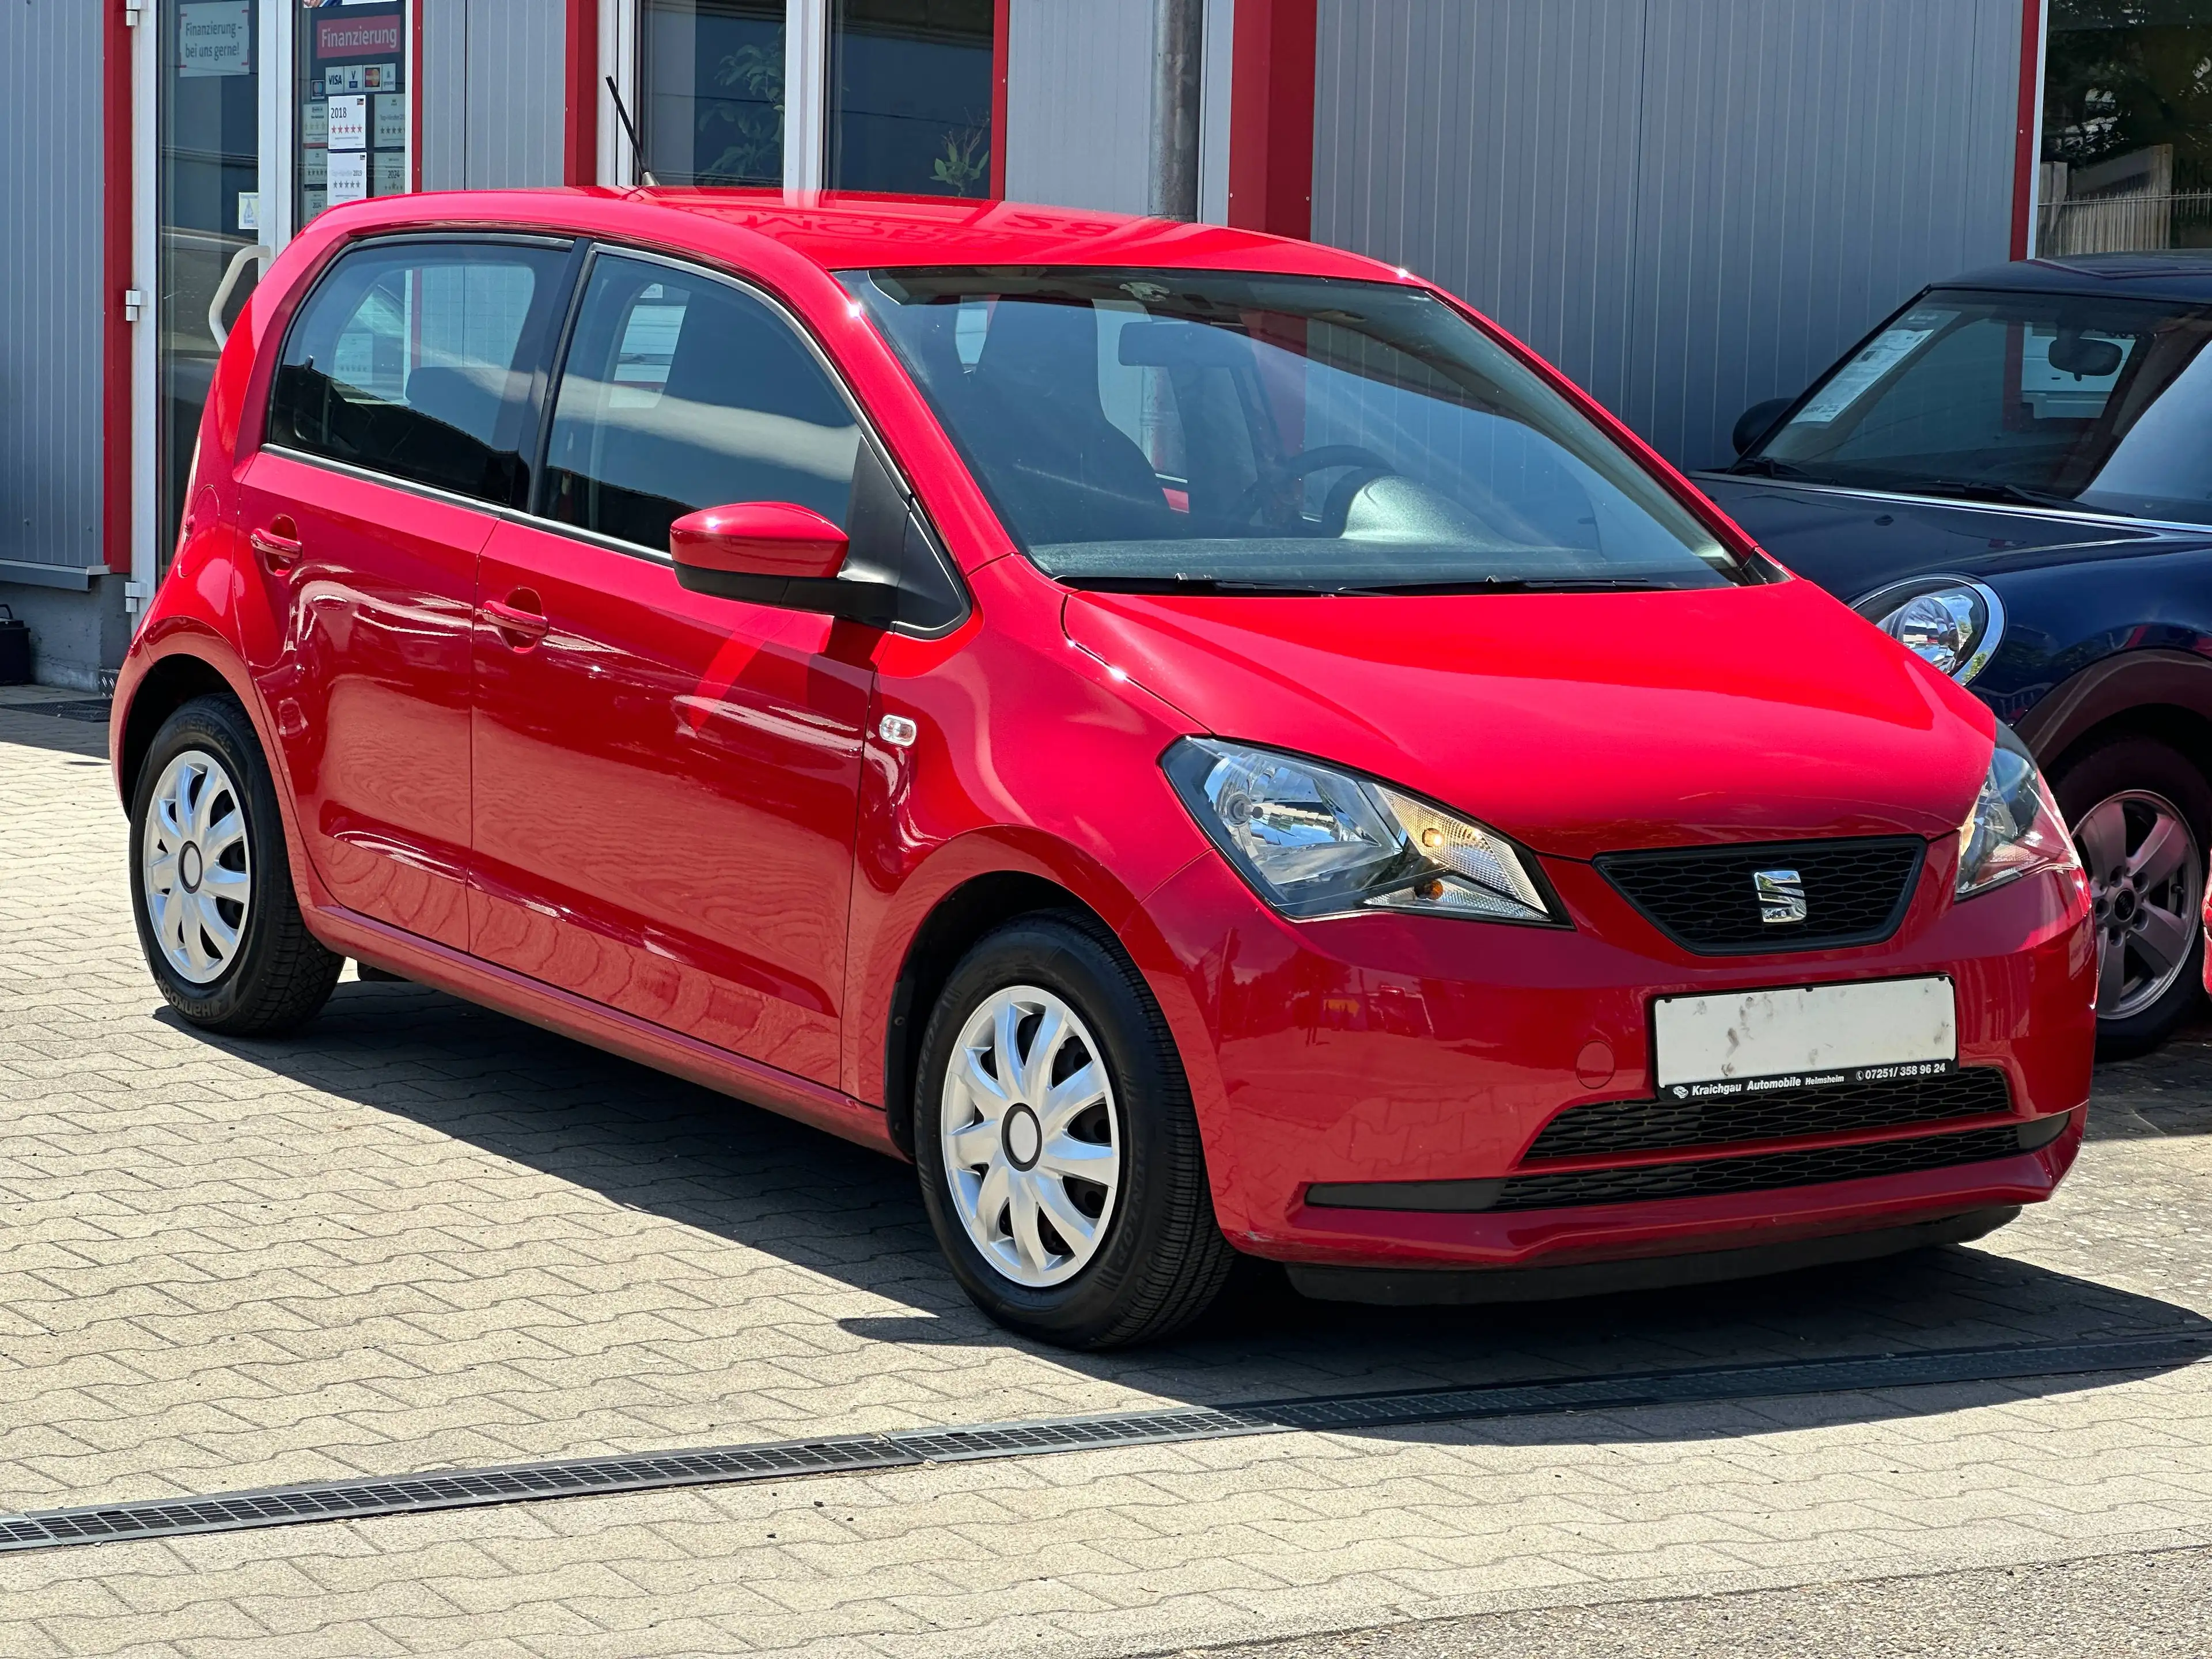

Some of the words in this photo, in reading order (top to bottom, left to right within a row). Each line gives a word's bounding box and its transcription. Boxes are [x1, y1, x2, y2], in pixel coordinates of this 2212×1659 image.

[185, 21, 236, 38] Finanzierung
[321, 25, 397, 48] Finanzierung
[185, 43, 197, 58] bei
[199, 46, 213, 57] uns
[214, 41, 240, 60] gerne!
[328, 74, 342, 85] VISA
[331, 107, 347, 119] 2018
[1692, 1084, 1742, 1096] Kraichgau
[1747, 1077, 1801, 1091] Automobile
[1865, 1067, 1899, 1080] 07251/
[1900, 1065, 1917, 1076] 358
[1919, 1064, 1931, 1074] 96
[1934, 1063, 1945, 1073] 24
